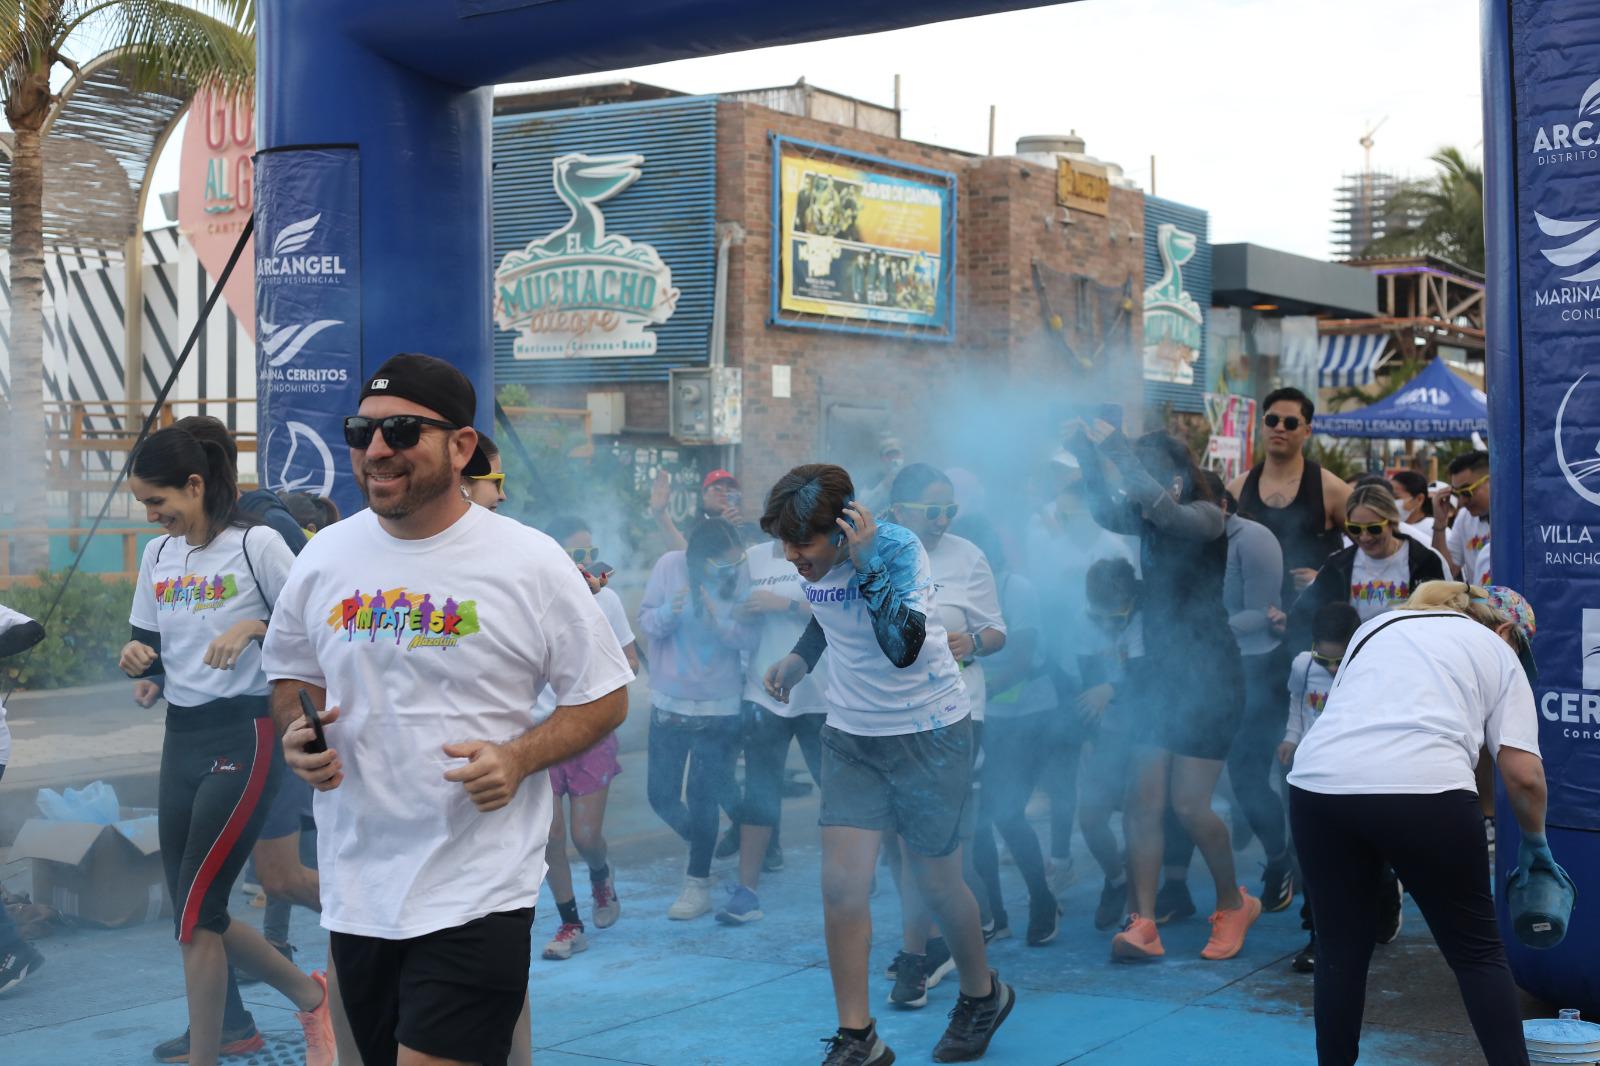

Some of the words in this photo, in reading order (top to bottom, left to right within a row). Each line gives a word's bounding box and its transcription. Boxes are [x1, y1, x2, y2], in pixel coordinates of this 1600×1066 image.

[1532, 120, 1600, 154] ARC
[1538, 149, 1598, 166] DISTRITO
[205, 158, 229, 200] AL
[566, 233, 584, 254] EL
[257, 256, 346, 275] ARCANGEL
[284, 276, 340, 284] RESIDENCIAL
[500, 269, 657, 318] MUCHACHO
[1535, 285, 1600, 307] MARINA
[1561, 308, 1600, 321] CON
[286, 368, 347, 381] CERRITOS
[1312, 418, 1362, 432] NUESTRO
[1365, 418, 1411, 432] LEGADO
[1414, 418, 1430, 432] ES
[1432, 418, 1447, 432] TU
[1540, 525, 1594, 544] VILLA
[342, 599, 422, 631] PINTATE
[430, 611, 462, 635] 5K
[1541, 691, 1600, 724] CER
